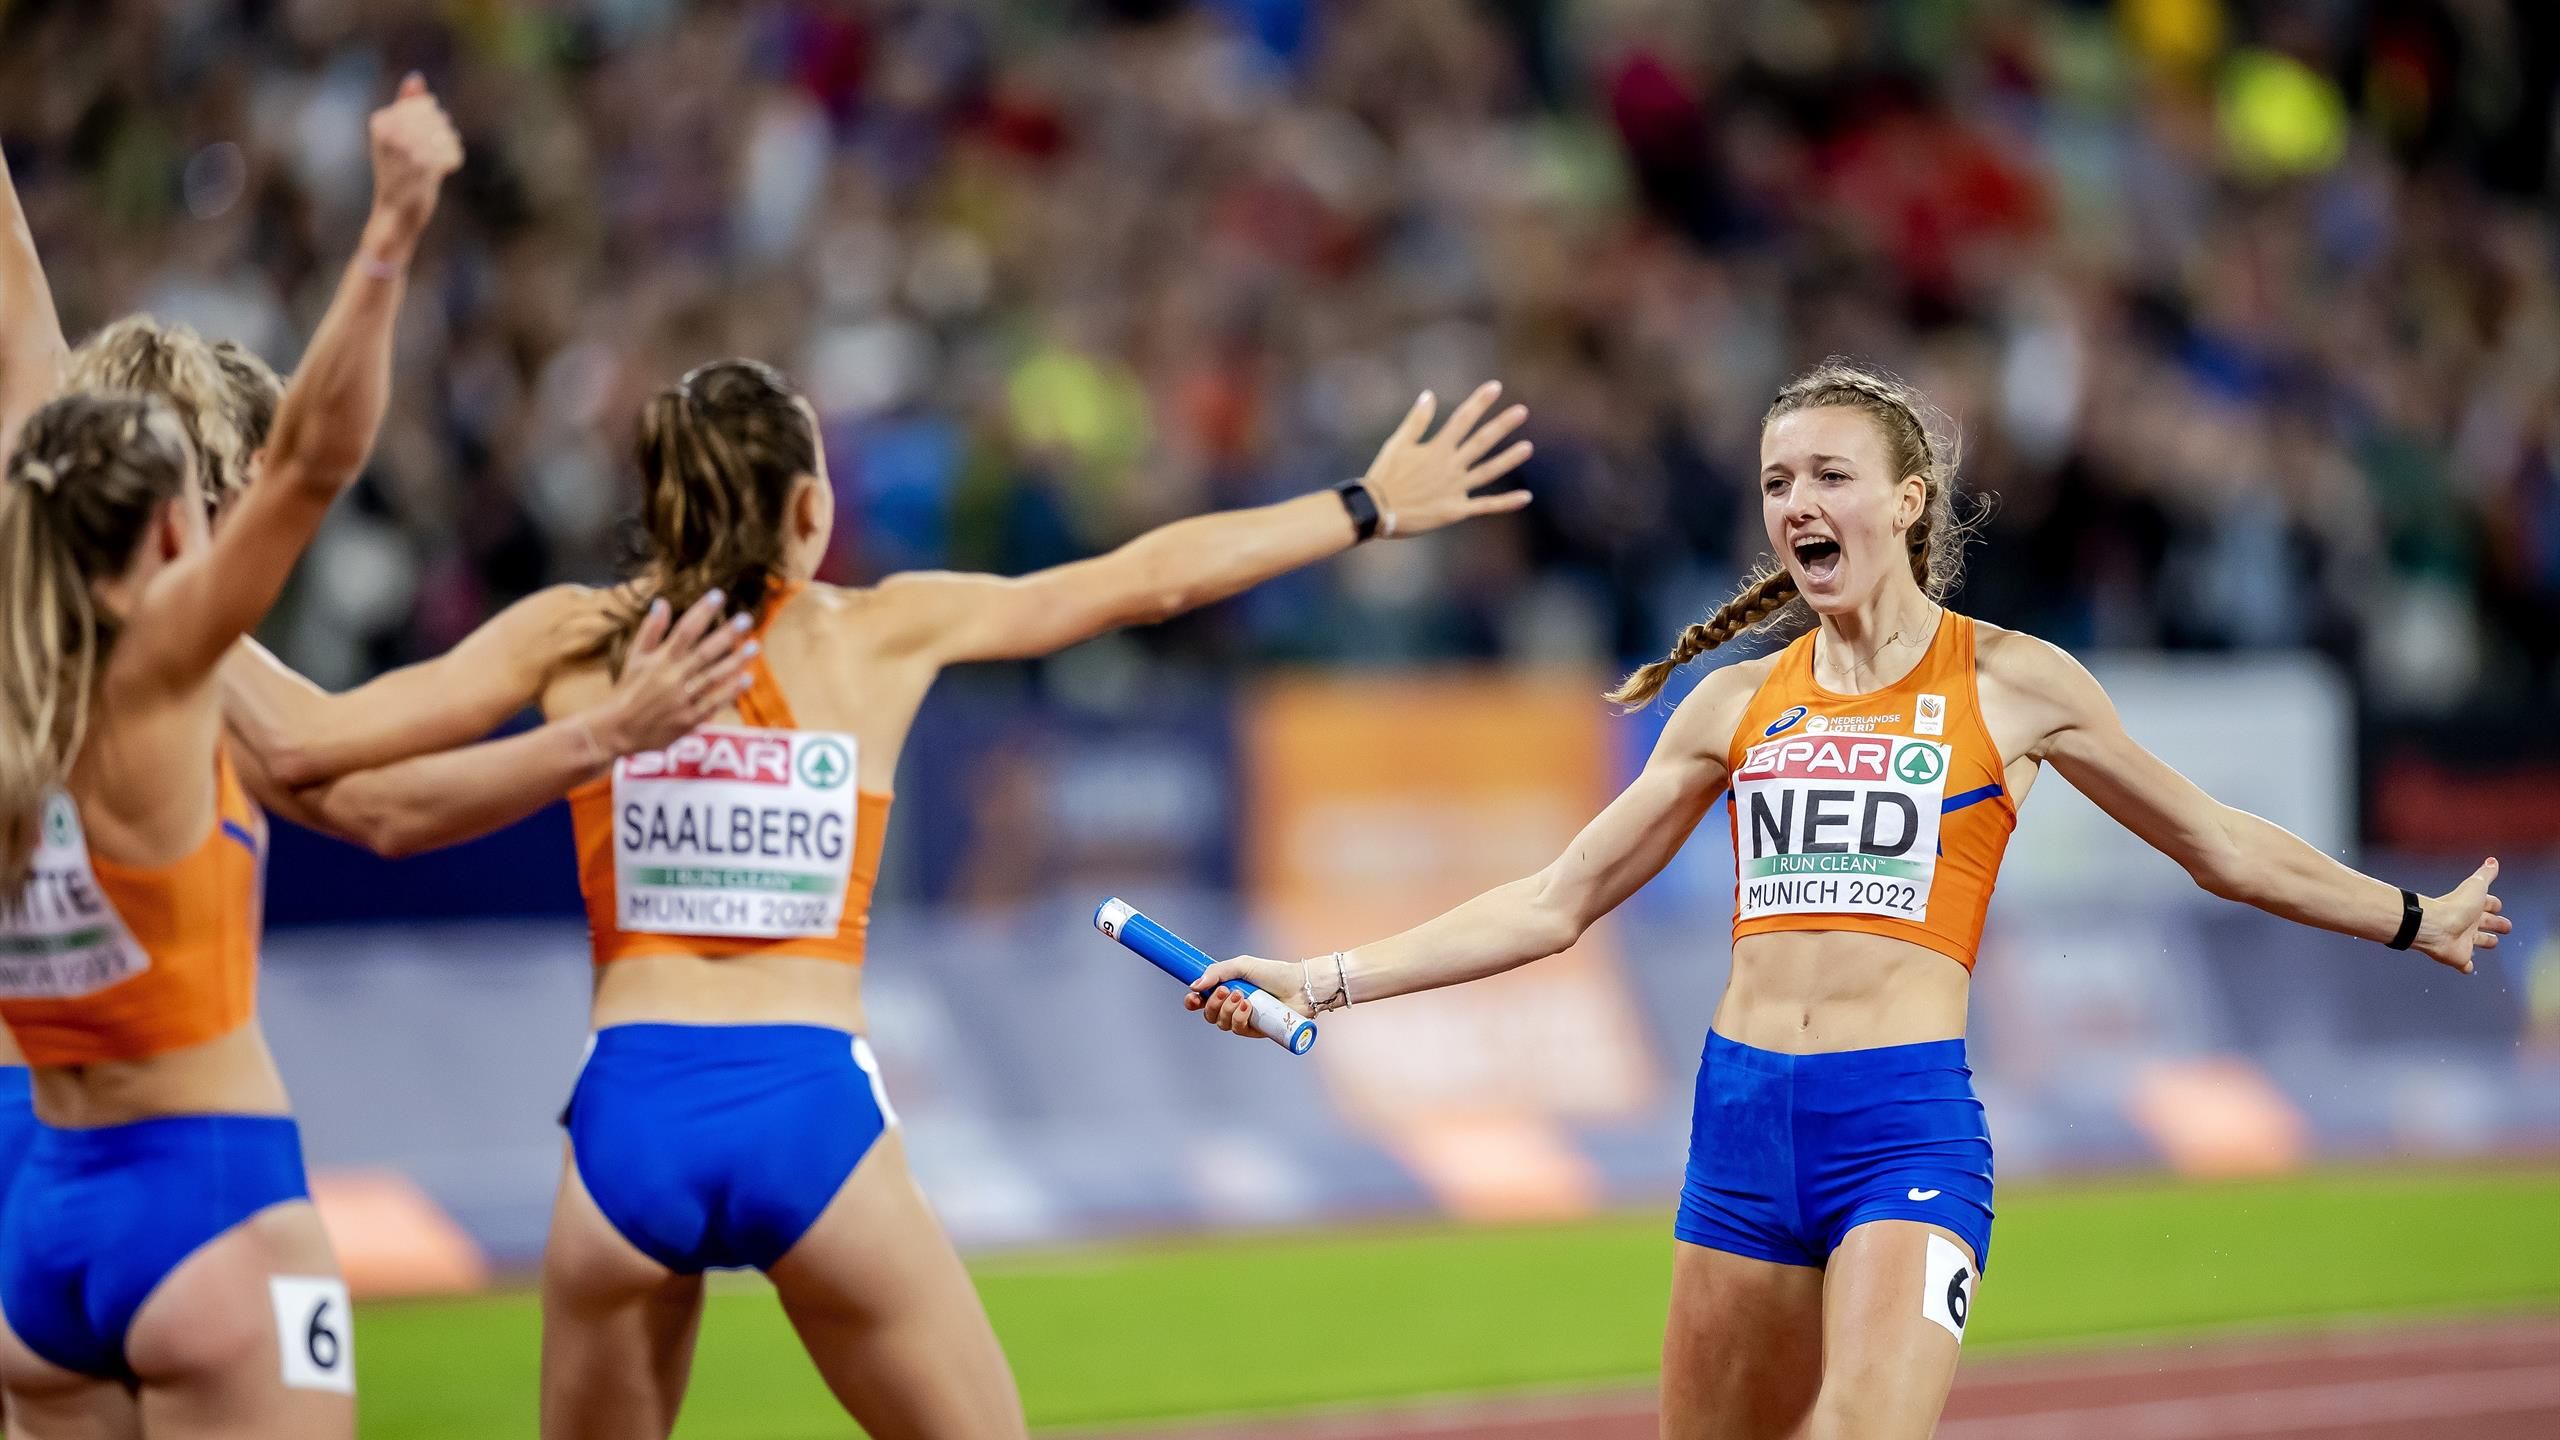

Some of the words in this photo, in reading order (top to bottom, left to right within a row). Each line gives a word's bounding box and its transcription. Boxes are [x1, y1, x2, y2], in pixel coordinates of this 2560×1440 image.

[1828, 724, 1875, 733] LOTERIJ
[1830, 714, 1901, 725] NEDERLANDSE
[628, 735, 786, 781] SPAR
[1744, 741, 1887, 775] SPAR
[622, 802, 844, 861] SAALBERG
[1750, 789, 1919, 859] NED
[1780, 857, 1815, 872] RUN
[629, 893, 749, 926] MUNICH
[760, 898, 829, 928] 2022
[1748, 880, 1839, 908] MUNICH
[1848, 881, 1916, 911] 2022
[1947, 1266, 1969, 1329] 6
[308, 1299, 340, 1369] 6
